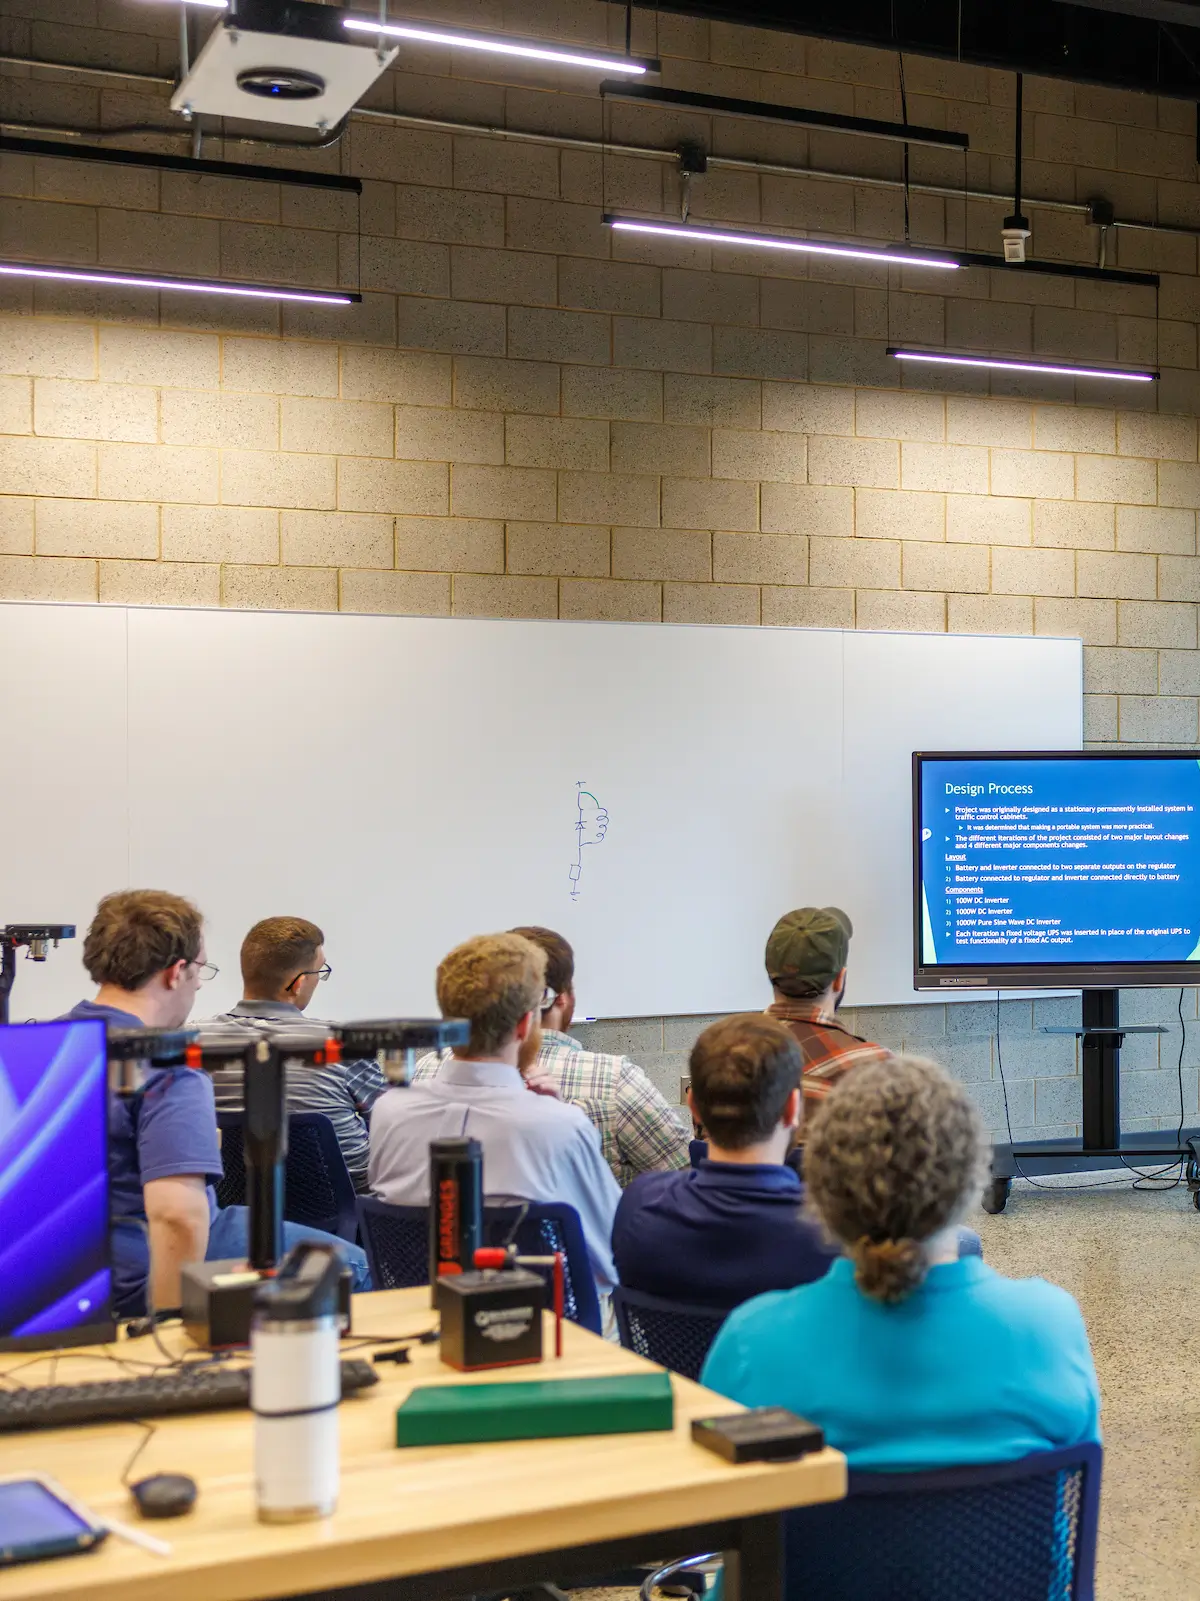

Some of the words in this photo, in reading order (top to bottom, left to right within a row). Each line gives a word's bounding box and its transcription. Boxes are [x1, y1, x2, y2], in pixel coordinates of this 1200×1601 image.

[945, 782, 984, 797] Design
[988, 782, 1033, 794] Process
[955, 806, 978, 814] Project
[992, 806, 1021, 814] originally
[945, 886, 984, 894] Components
[1023, 929, 1046, 938] voltage
[1146, 928, 1169, 936] original
[970, 936, 1009, 945] functionality
